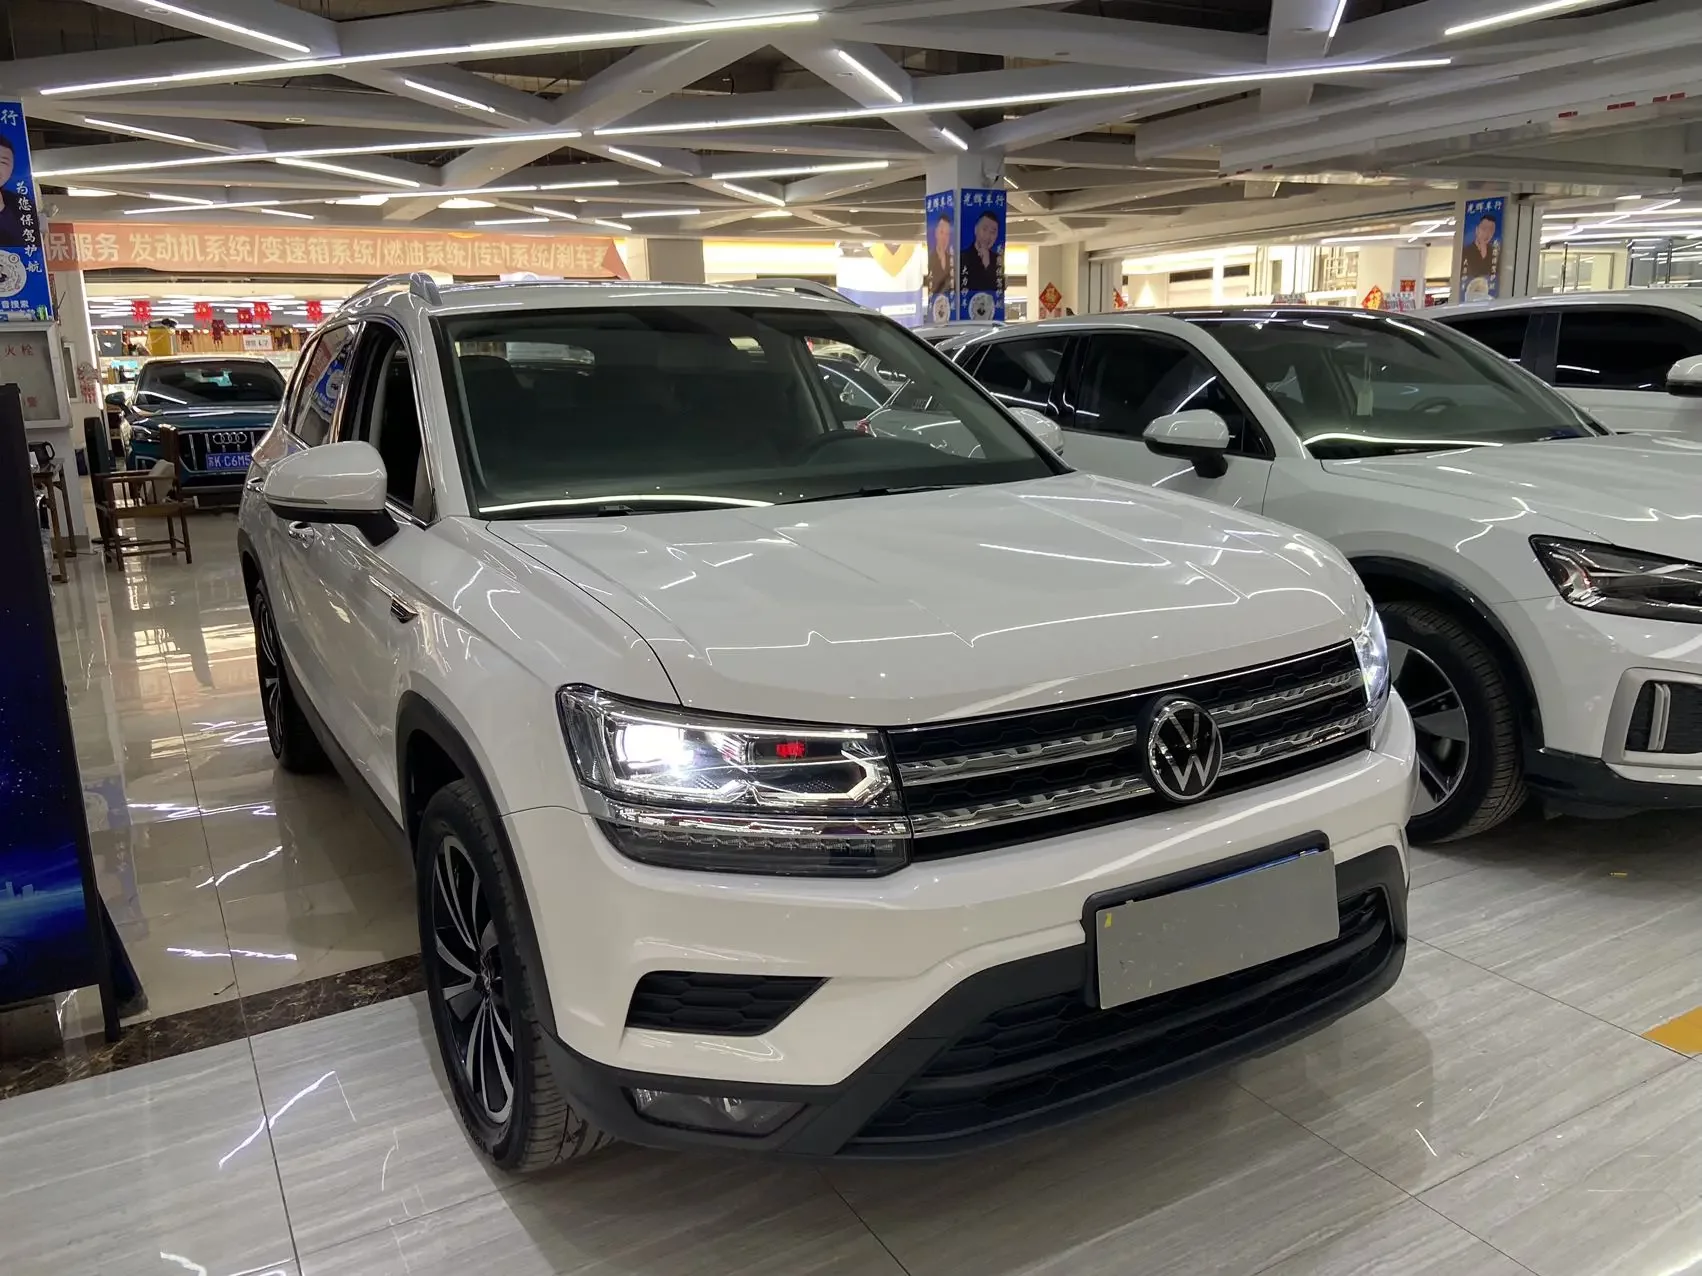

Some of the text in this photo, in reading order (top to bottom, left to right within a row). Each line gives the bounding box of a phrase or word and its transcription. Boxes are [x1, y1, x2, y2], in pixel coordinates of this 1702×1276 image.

[15, 181, 42, 273] 为您保驾护航
